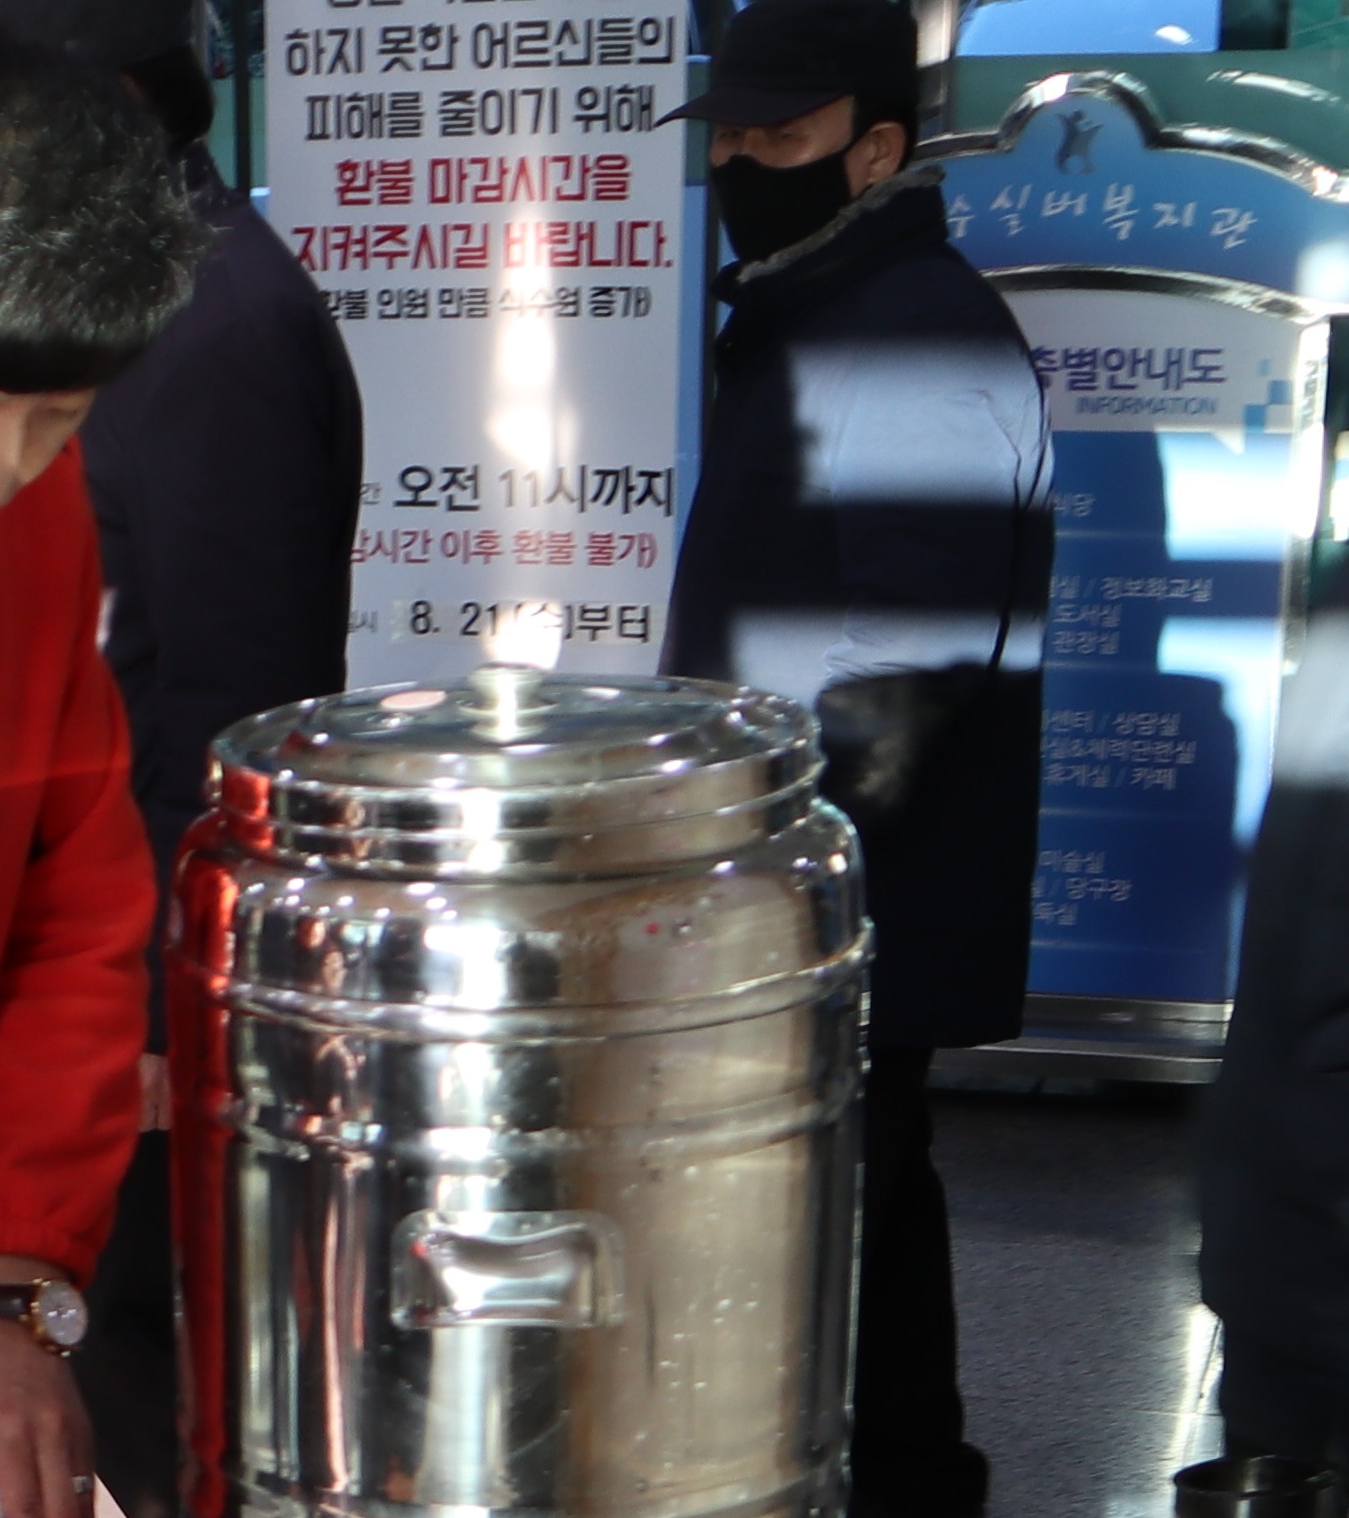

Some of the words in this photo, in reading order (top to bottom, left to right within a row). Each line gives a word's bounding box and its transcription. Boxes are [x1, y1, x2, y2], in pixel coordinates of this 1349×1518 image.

[284, 26, 363, 76] 하지
[377, 22, 459, 72] 못한
[472, 16, 676, 69] 어르신들의
[304, 90, 425, 141] 피해를
[438, 88, 559, 137] 줄이기
[572, 84, 656, 134] 위해
[333, 158, 414, 207] 환불
[428, 154, 633, 204] 마감시간을
[291, 222, 490, 272] 지켜주시길
[503, 219, 674, 269] 바랍니다.
[377, 288, 430, 320] 인원
[438, 286, 490, 319] 만큼
[393, 464, 481, 512] 오전
[498, 464, 675, 518] 11시까지
[440, 528, 503, 565] 이후
[512, 530, 577, 566] 환불
[409, 600, 441, 635] 8.
